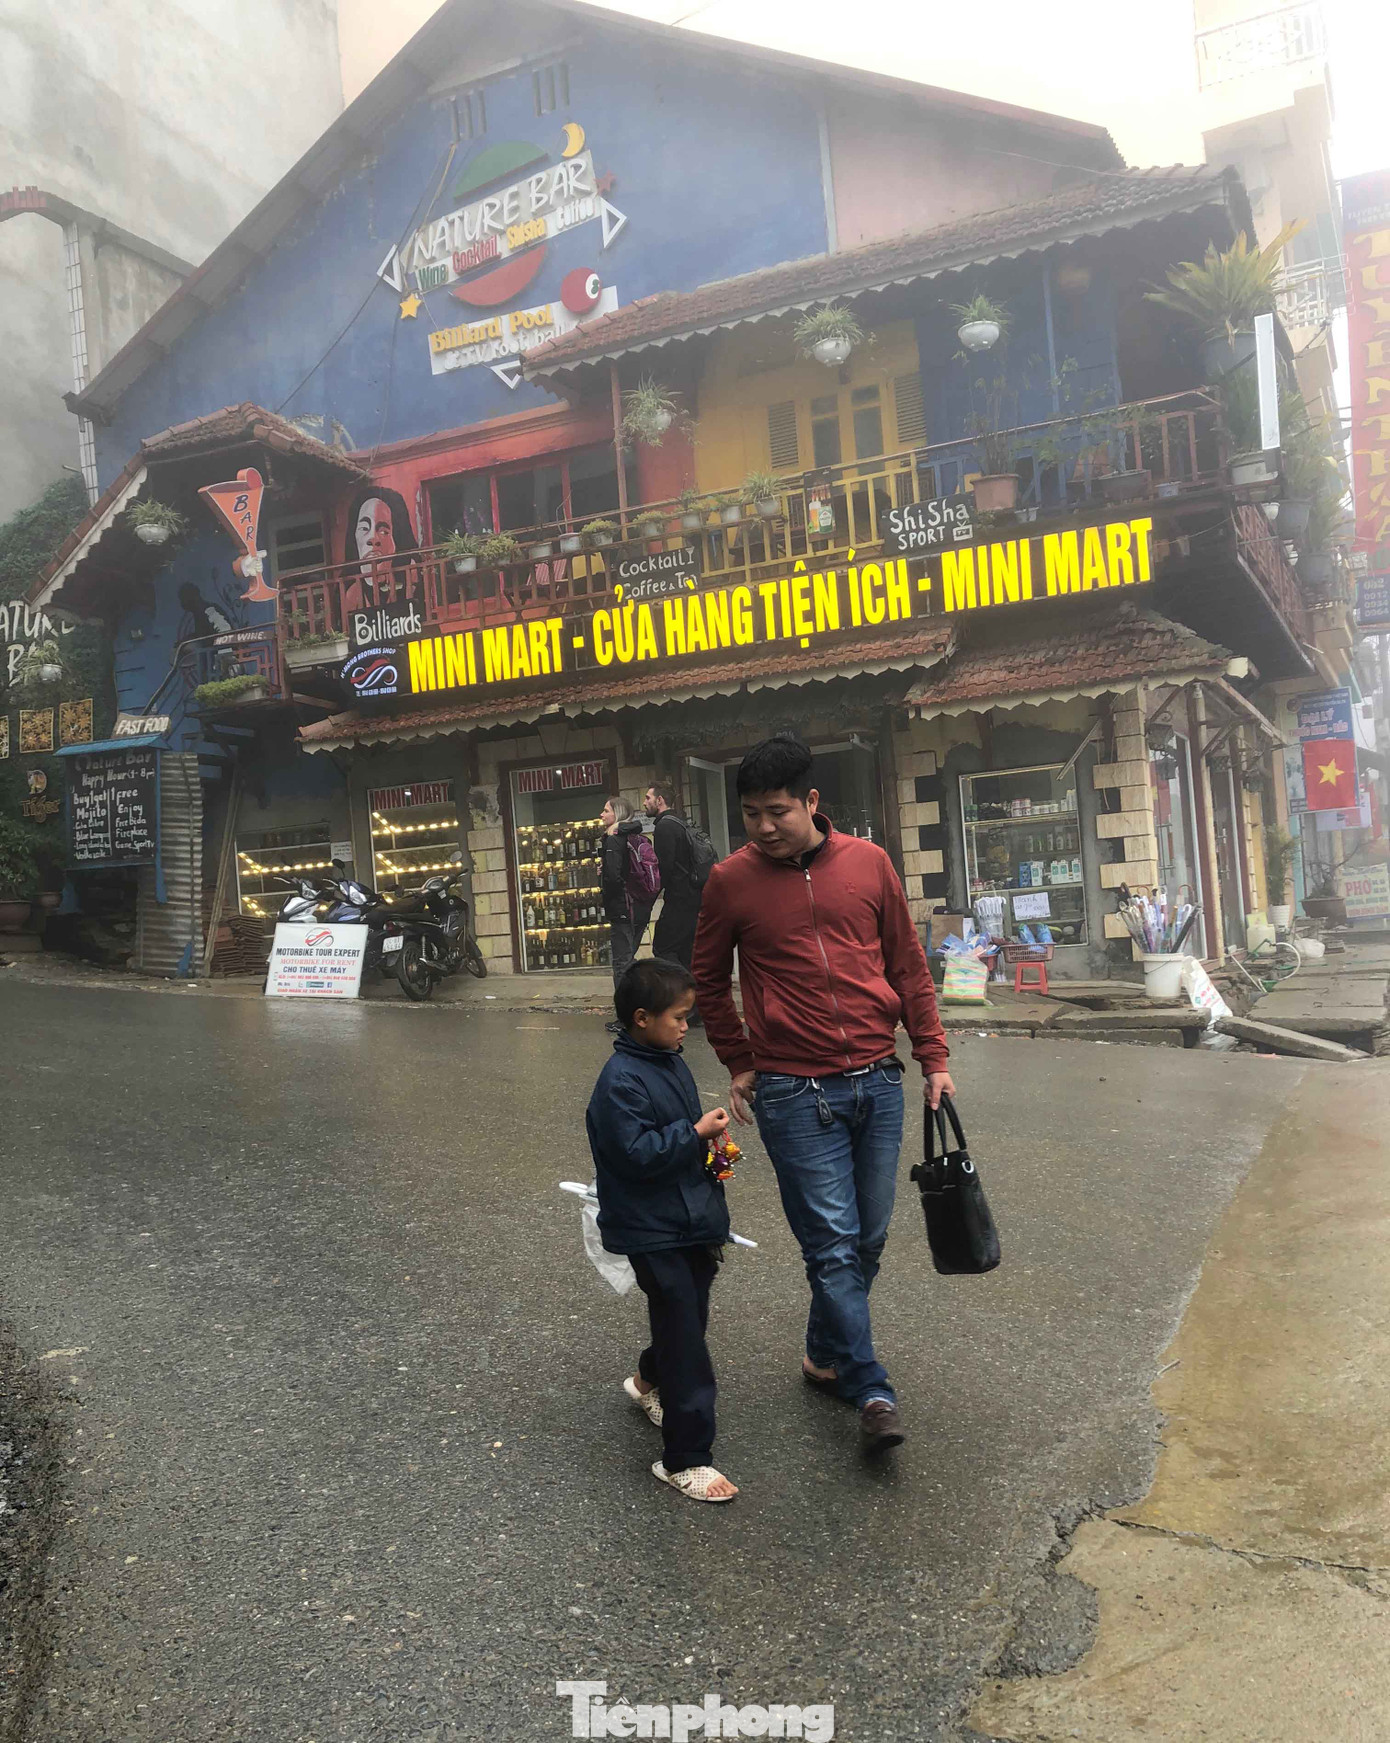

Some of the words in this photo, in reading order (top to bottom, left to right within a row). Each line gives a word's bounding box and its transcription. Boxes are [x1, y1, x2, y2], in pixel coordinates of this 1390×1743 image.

[413, 188, 520, 266] NATURE
[528, 158, 592, 213] BAR
[418, 264, 449, 290] Wine
[452, 235, 501, 273] Cocktail
[429, 318, 502, 353] Billiard
[508, 304, 554, 334] Pool
[234, 495, 254, 541] BAR
[898, 526, 945, 550] SPORT
[619, 553, 686, 578] Cocktail
[408, 632, 477, 694] MINI
[482, 617, 563, 683] MART
[592, 584, 658, 666] CỬA
[663, 579, 754, 656] HÀNG
[759, 559, 840, 649] TIỆN
[847, 547, 911, 627] ÍCH
[941, 538, 1033, 612] MINI
[1043, 517, 1153, 597] MART
[355, 602, 422, 646] Billiards
[357, 647, 382, 661] BROTHERS
[382, 647, 397, 655] SHOP
[115, 719, 142, 735] FAST
[143, 717, 169, 733] FOOD
[126, 752, 152, 765] Bar
[82, 773, 105, 788] Happy
[518, 769, 553, 794] MINI
[561, 762, 602, 789] MART
[373, 787, 408, 811] MINI
[410, 782, 449, 806] MART
[77, 807, 107, 822] Mojito
[117, 804, 143, 817] Enjoy
[276, 947, 314, 957] MOTORBIKE
[315, 948, 333, 957] TOUR
[334, 949, 360, 959] EXPERT
[335, 959, 357, 967] RENT
[283, 966, 297, 974] CHO
